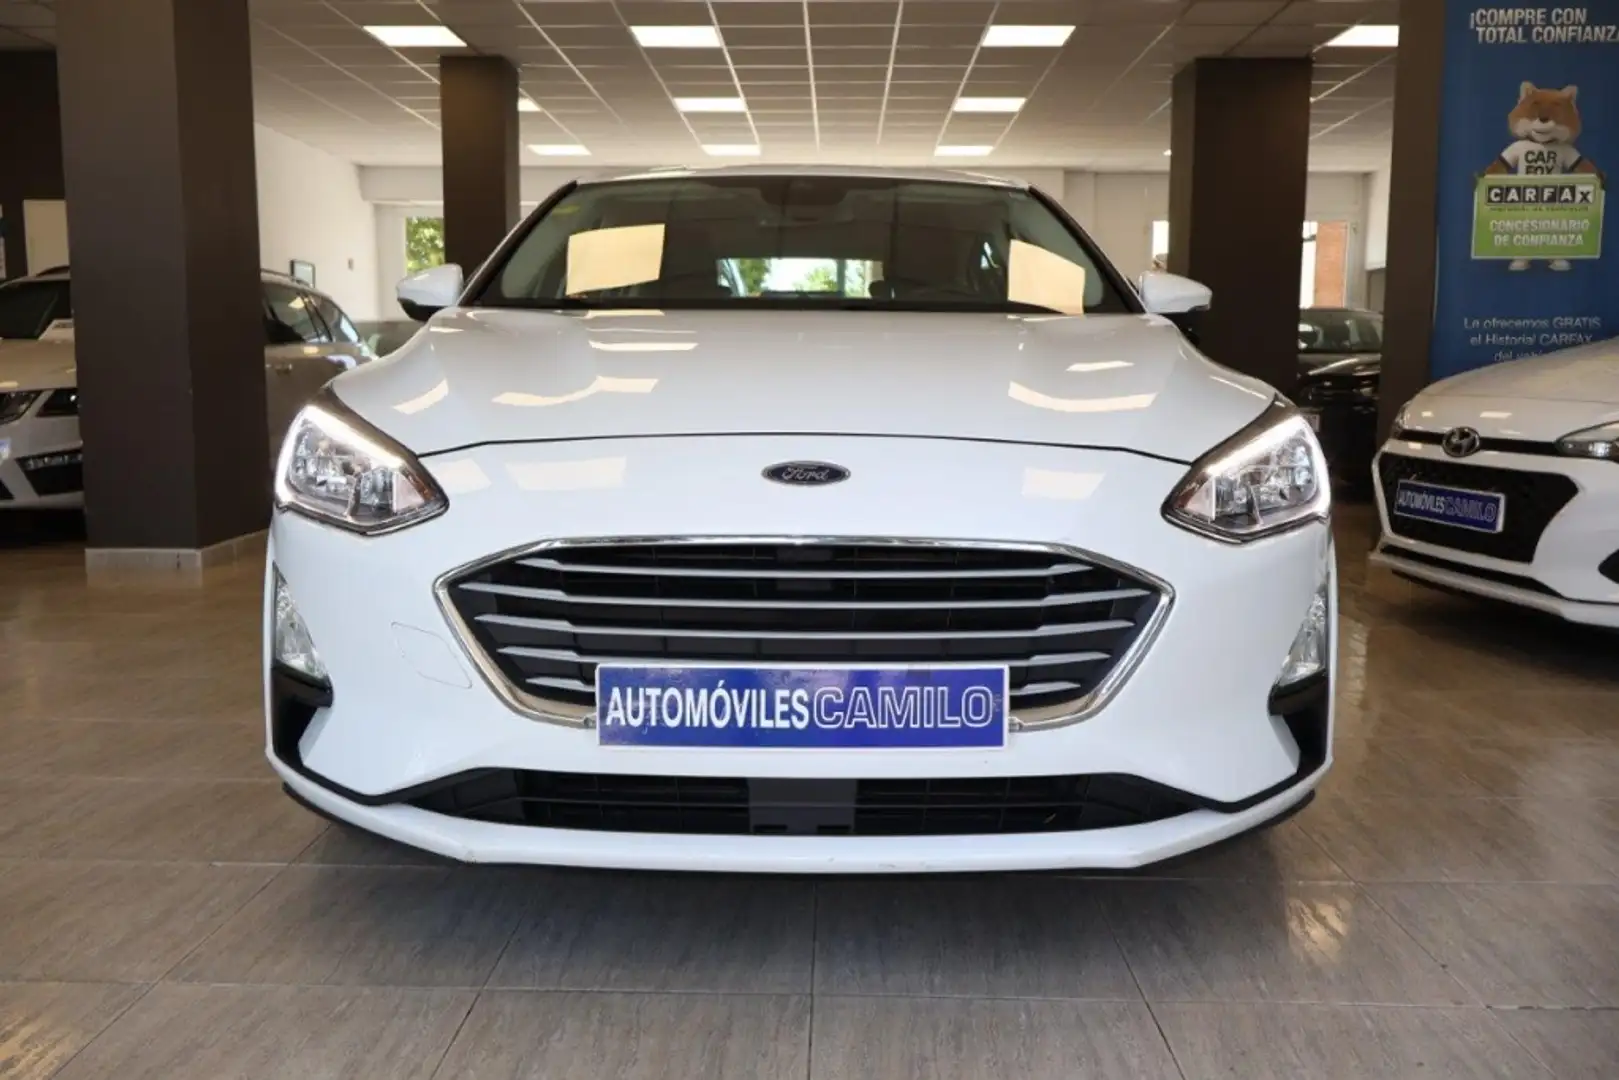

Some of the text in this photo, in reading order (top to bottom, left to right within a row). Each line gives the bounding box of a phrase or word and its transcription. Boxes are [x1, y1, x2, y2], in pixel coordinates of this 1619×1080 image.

[1551, 8, 1587, 25] CON
[1476, 26, 1527, 43] TOTAL
[1524, 150, 1557, 164] CAR
[1488, 187, 1593, 203] CARFAX
[1489, 219, 1590, 232] CONCESIONARIO
[1494, 234, 1583, 246] DE CONFIANZA
[1483, 317, 1550, 329] ofrecemos
[1552, 316, 1601, 329] GRATIS
[1470, 334, 1481, 346] el
[1485, 333, 1536, 346] Historial
[781, 466, 830, 480] Ford
